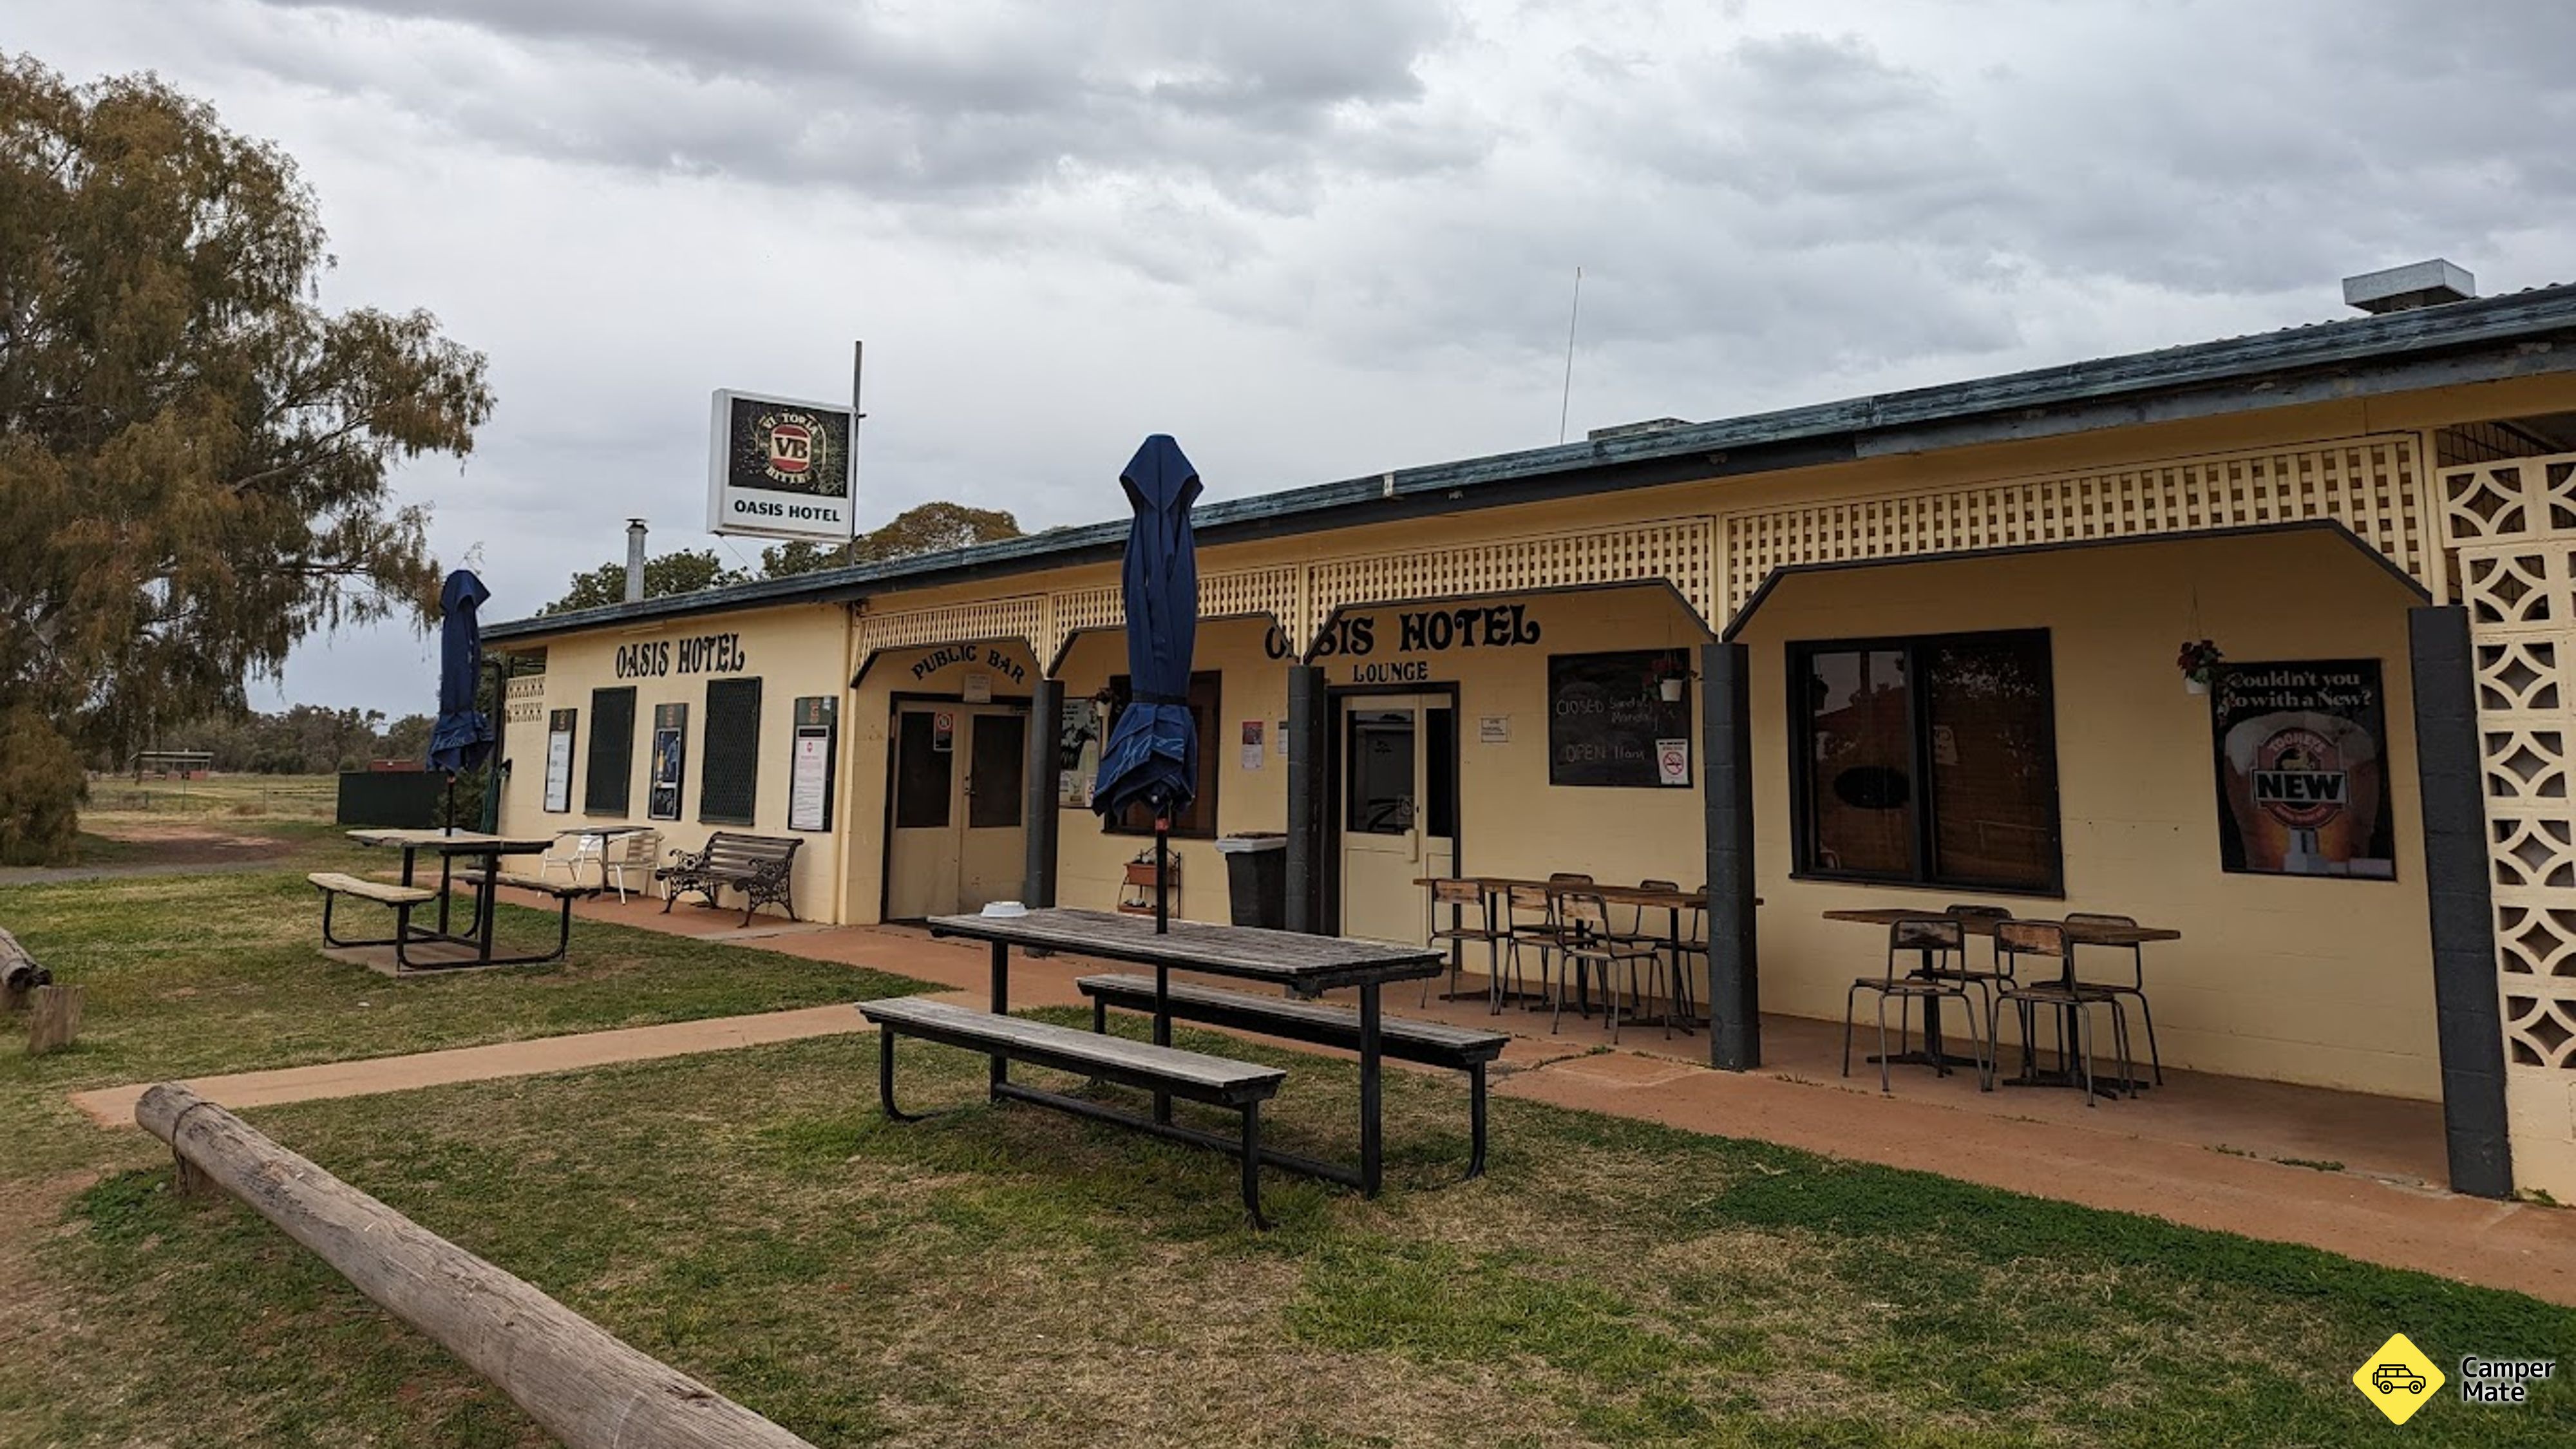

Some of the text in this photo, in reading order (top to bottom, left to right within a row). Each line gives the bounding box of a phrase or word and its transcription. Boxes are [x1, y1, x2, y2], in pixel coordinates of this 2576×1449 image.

[762, 413, 819, 435] VITORIA
[774, 437, 808, 459] VB
[734, 499, 840, 522] OASIS HOTEL
[1265, 603, 1541, 659] OSIS HOTEL
[616, 632, 746, 679] OASIS HOTEL
[911, 645, 977, 681] PUBLIC
[987, 649, 1026, 685] BAR
[1353, 660, 1428, 683] LOUNGE
[2228, 670, 2360, 691] Couldn't you
[2249, 690, 2299, 707] with
[2302, 695, 2315, 707] a
[2316, 688, 2373, 707] New?
[1566, 744, 1606, 762] OPEN
[2257, 774, 2344, 800] NEW
